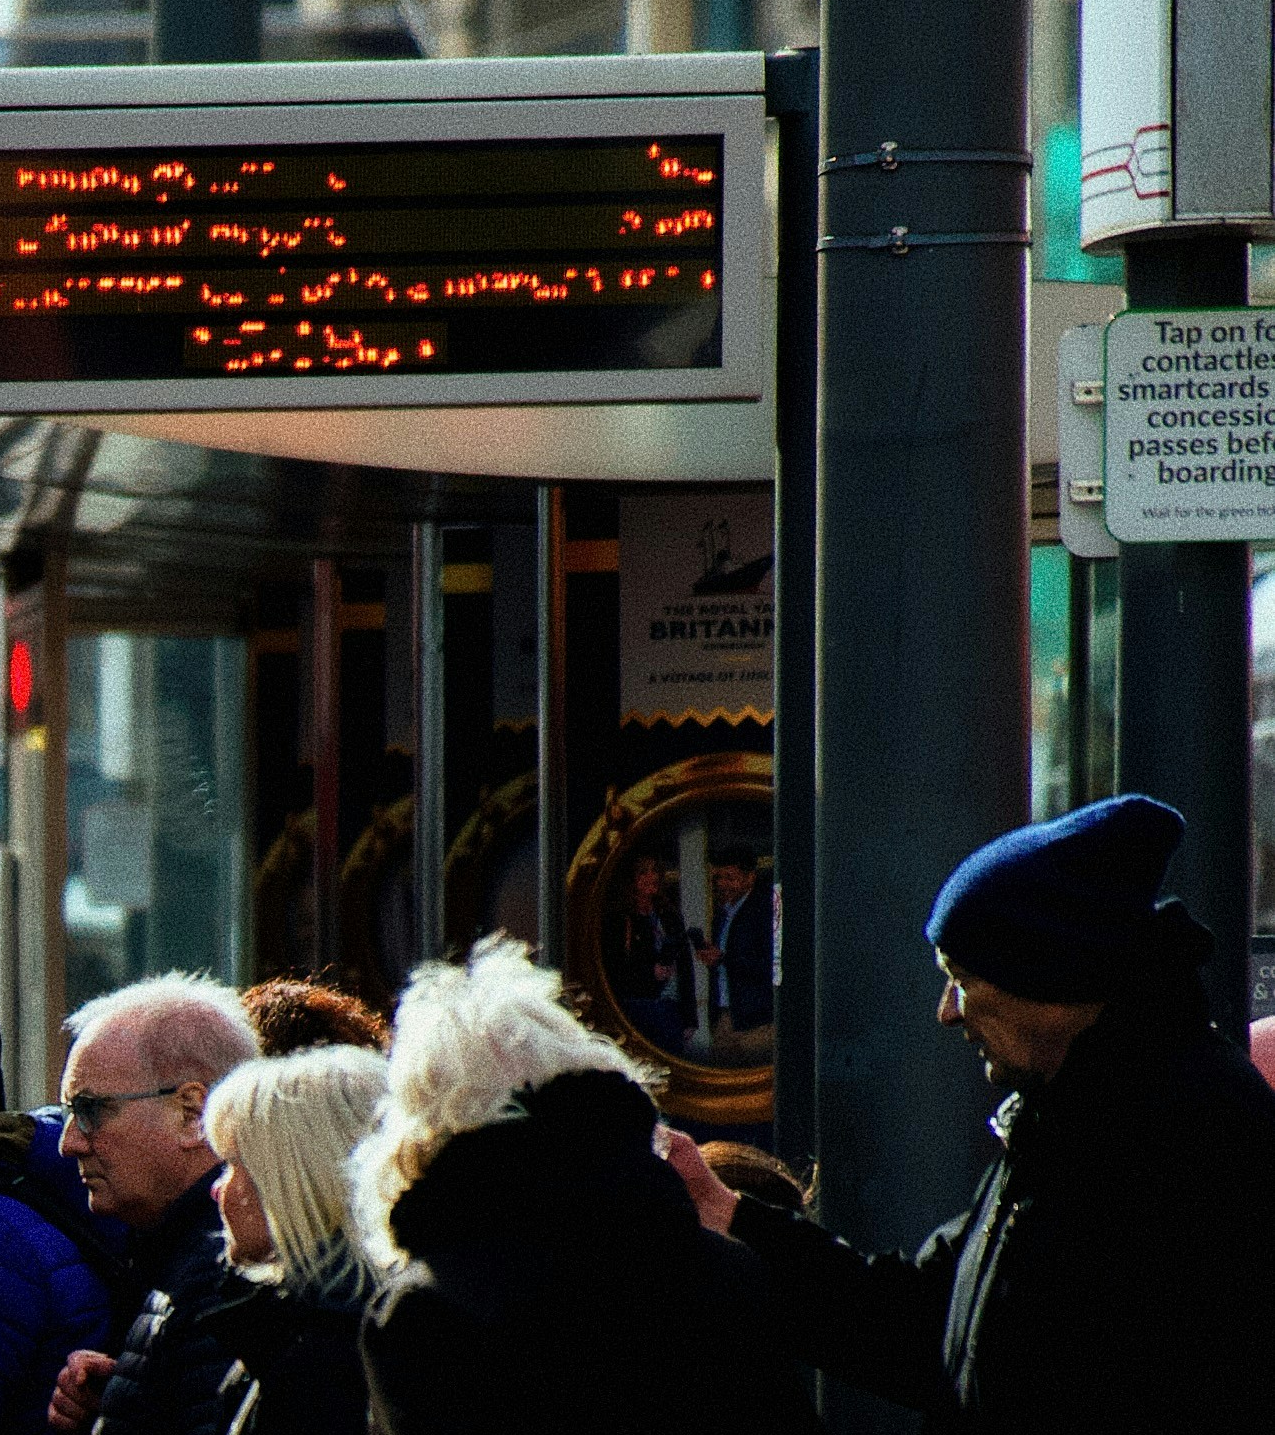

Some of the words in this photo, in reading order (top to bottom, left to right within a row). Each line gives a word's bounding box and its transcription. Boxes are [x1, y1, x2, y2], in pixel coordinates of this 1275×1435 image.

[1155, 320, 1202, 348] Tap
[1211, 326, 1245, 343] on
[1141, 346, 1275, 372] contactle
[1117, 376, 1270, 401] smartcards
[1128, 436, 1218, 461] passes
[1227, 431, 1275, 455] bef
[1158, 459, 1275, 486] boarding
[699, 603, 747, 615] ROYAL
